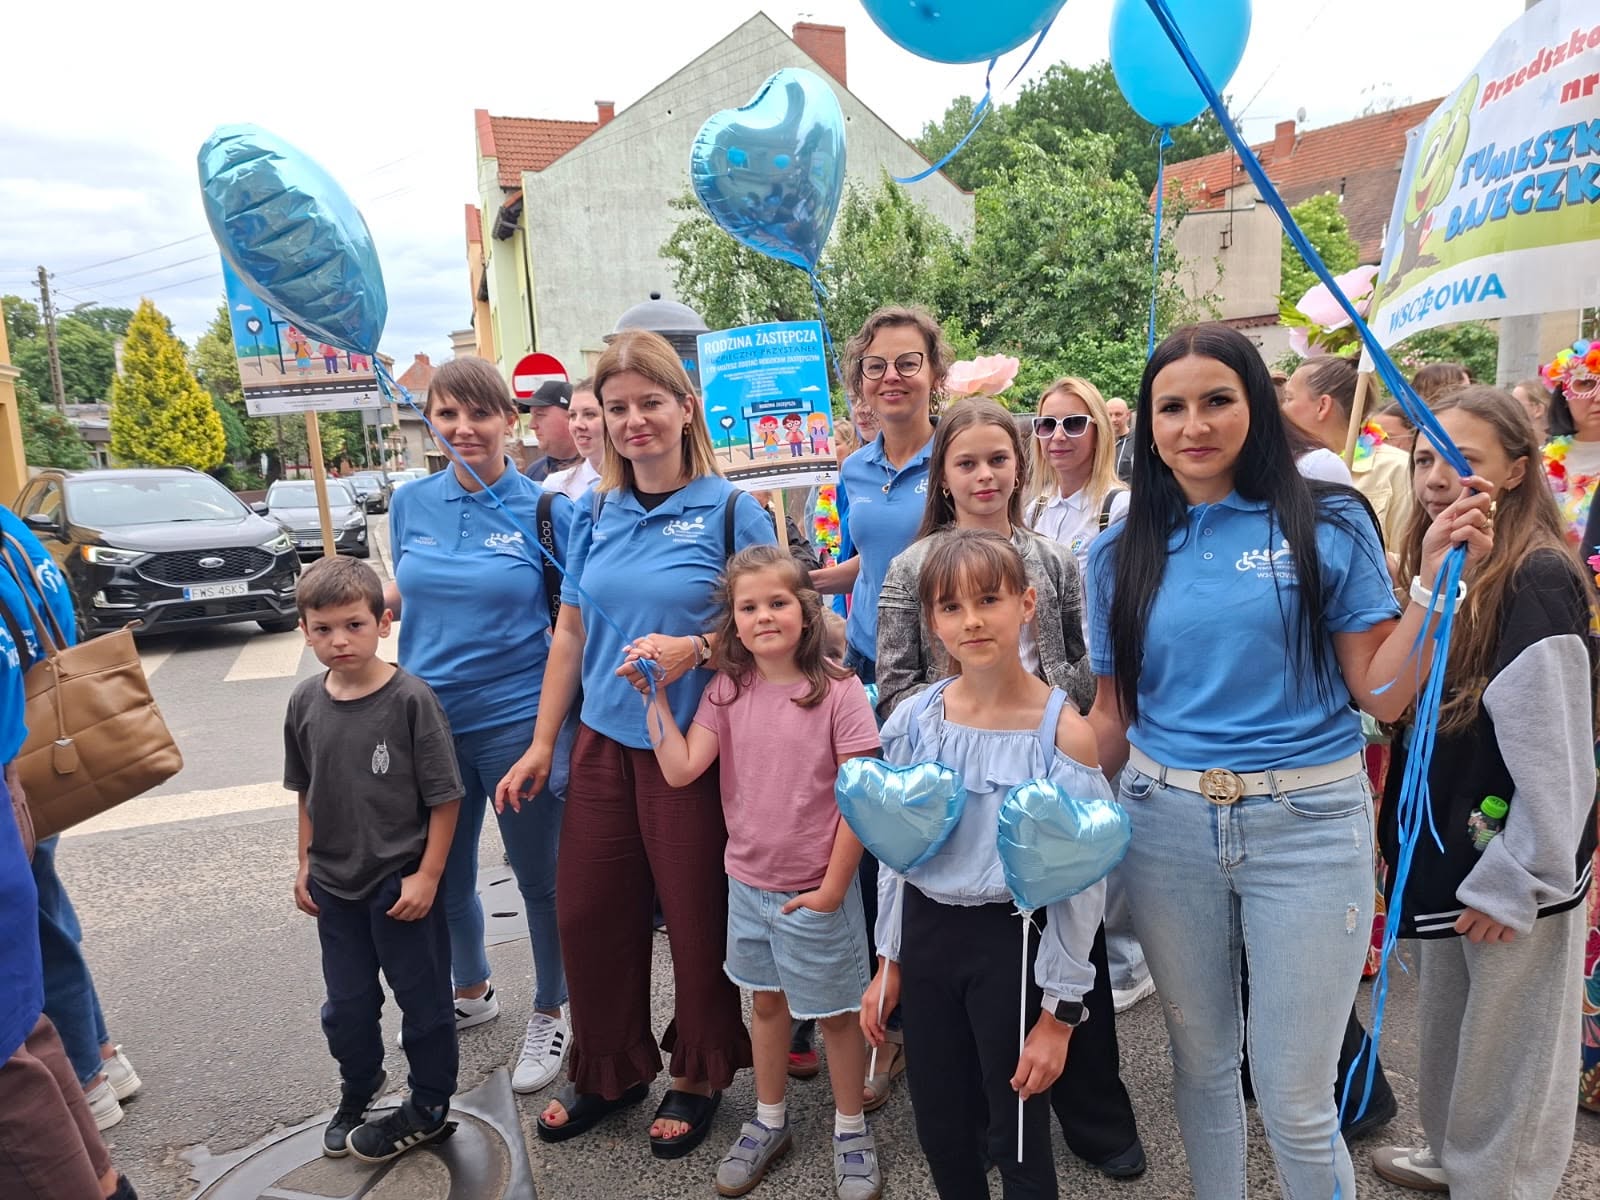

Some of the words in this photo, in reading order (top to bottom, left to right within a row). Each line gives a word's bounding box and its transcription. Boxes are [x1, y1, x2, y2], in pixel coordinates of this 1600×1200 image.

[1560, 72, 1600, 104] nr
[1444, 162, 1600, 242] BAJECZK
[703, 335, 753, 355] RODZINA
[705, 351, 756, 364] EZPIECZNY
